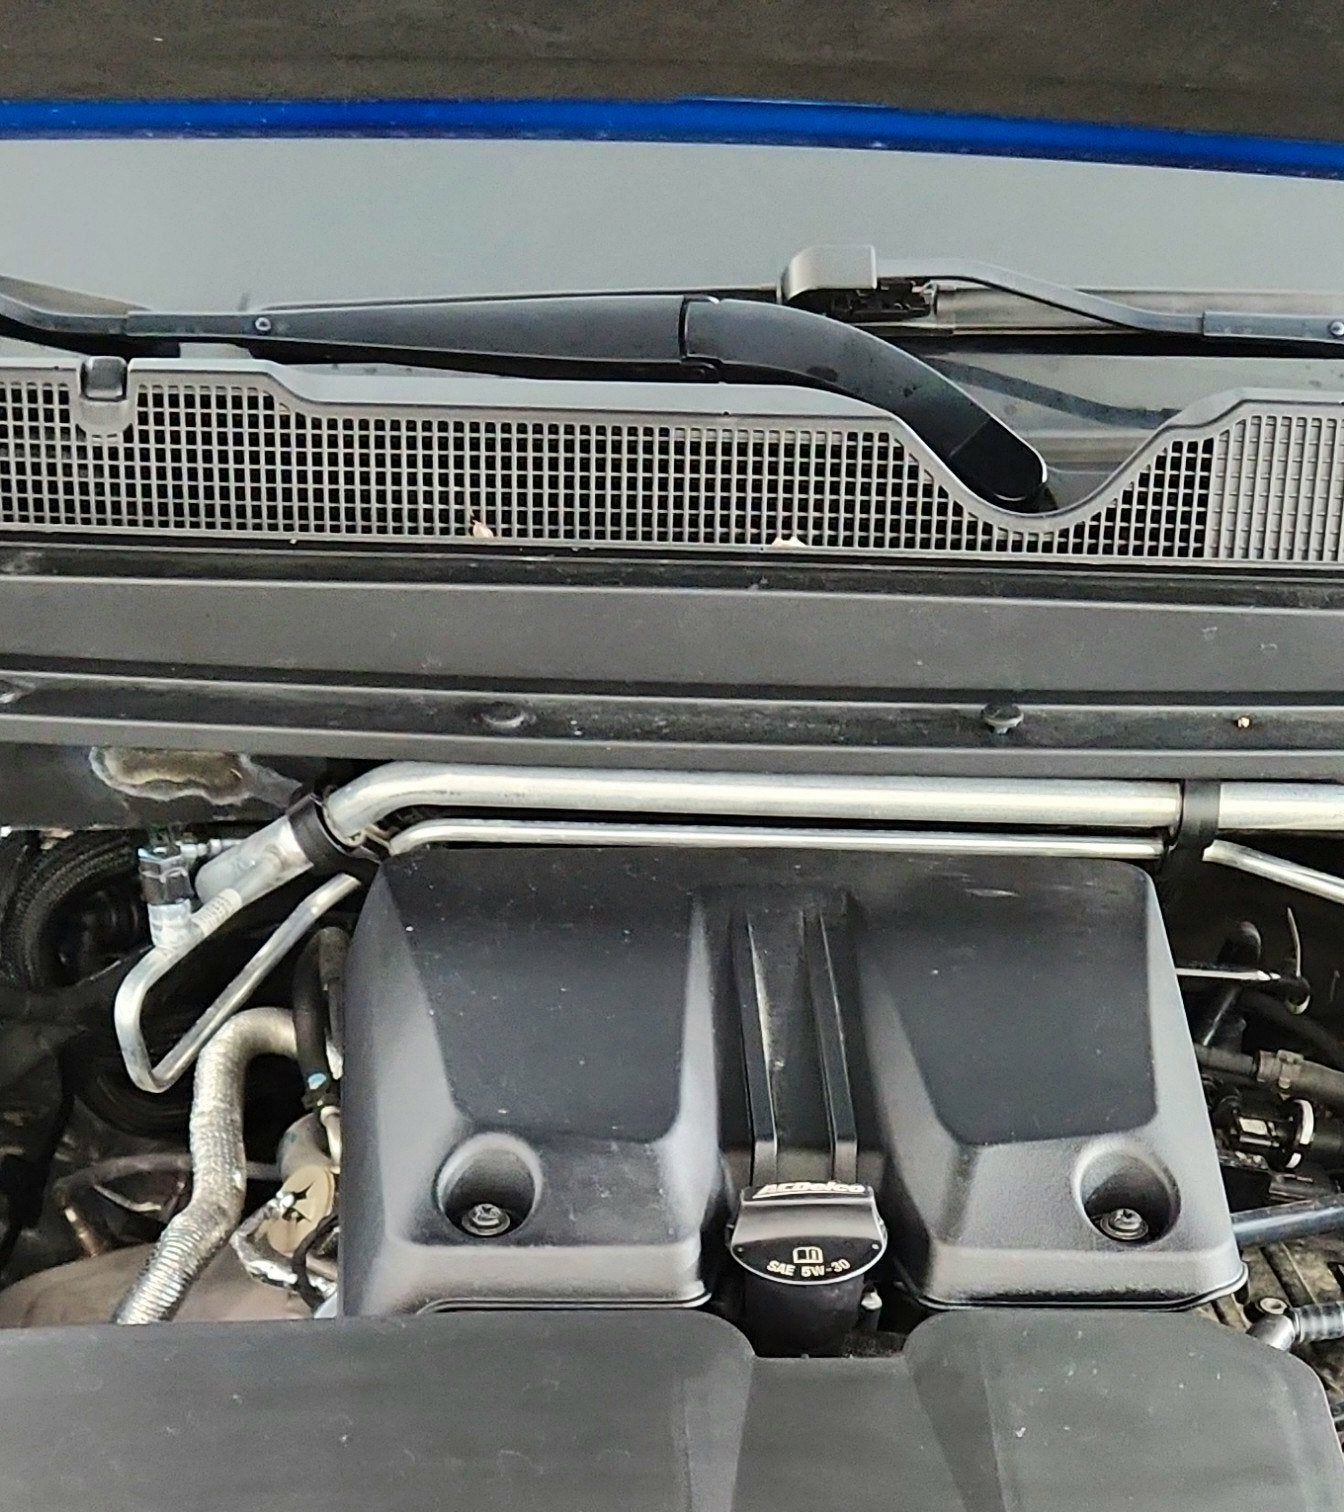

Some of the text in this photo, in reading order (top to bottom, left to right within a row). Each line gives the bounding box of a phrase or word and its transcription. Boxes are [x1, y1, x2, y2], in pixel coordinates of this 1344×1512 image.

[759, 1181, 866, 1194] ACDelco
[766, 1258, 851, 1278] SAE 5W-30
